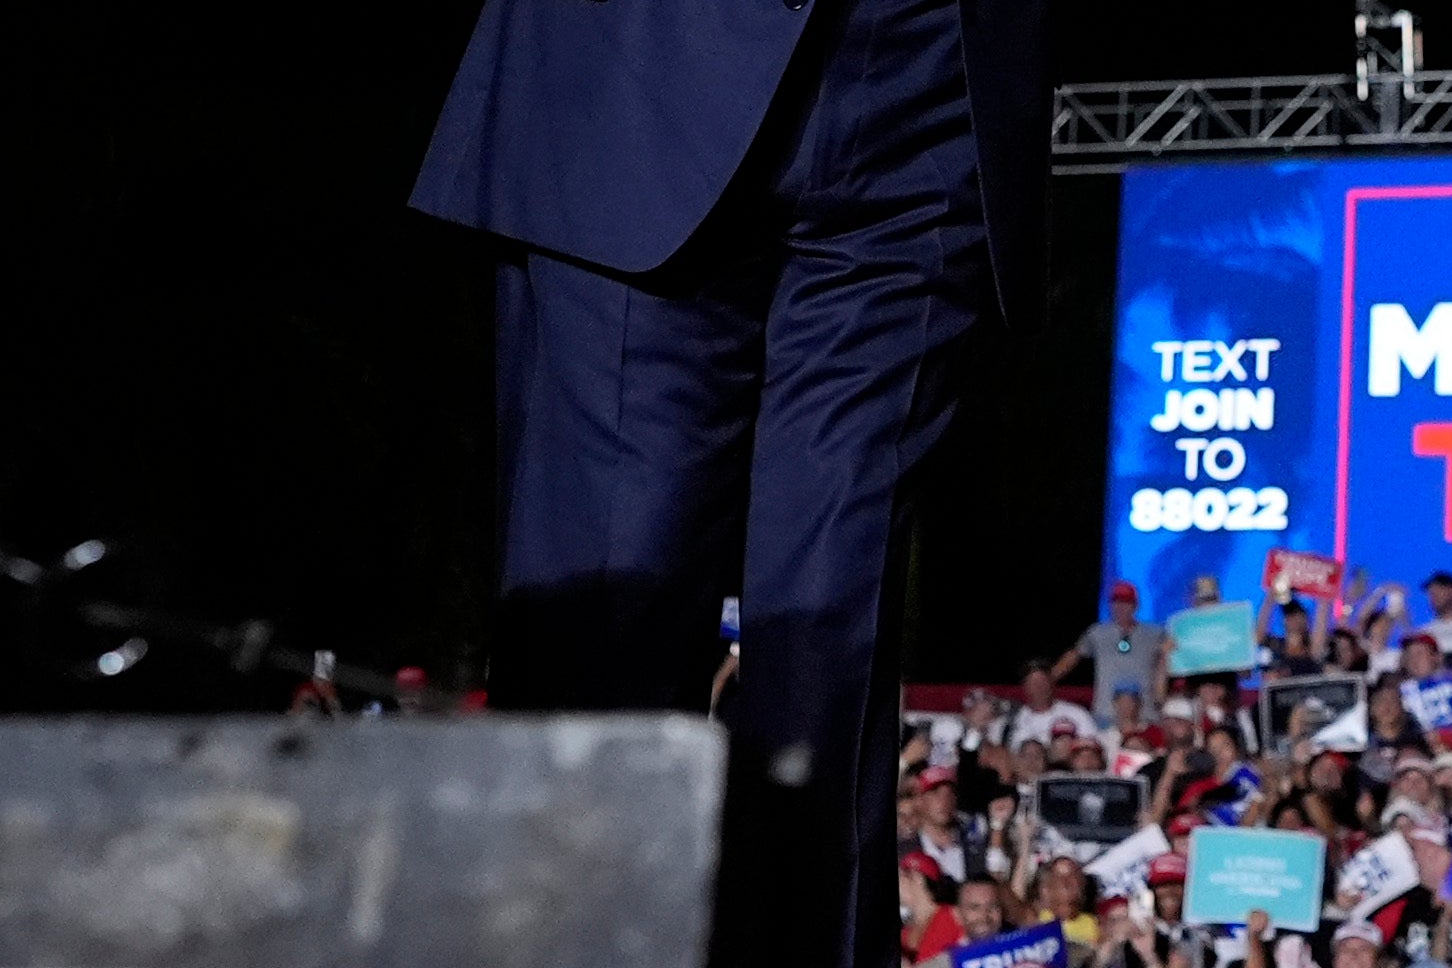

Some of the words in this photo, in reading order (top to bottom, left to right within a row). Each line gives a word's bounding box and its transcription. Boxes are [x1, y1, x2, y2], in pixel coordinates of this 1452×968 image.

[1152, 339, 1280, 382] TEXT
[1151, 387, 1275, 432] JOIN
[1175, 437, 1246, 481] TO
[1130, 487, 1288, 531] 88022
